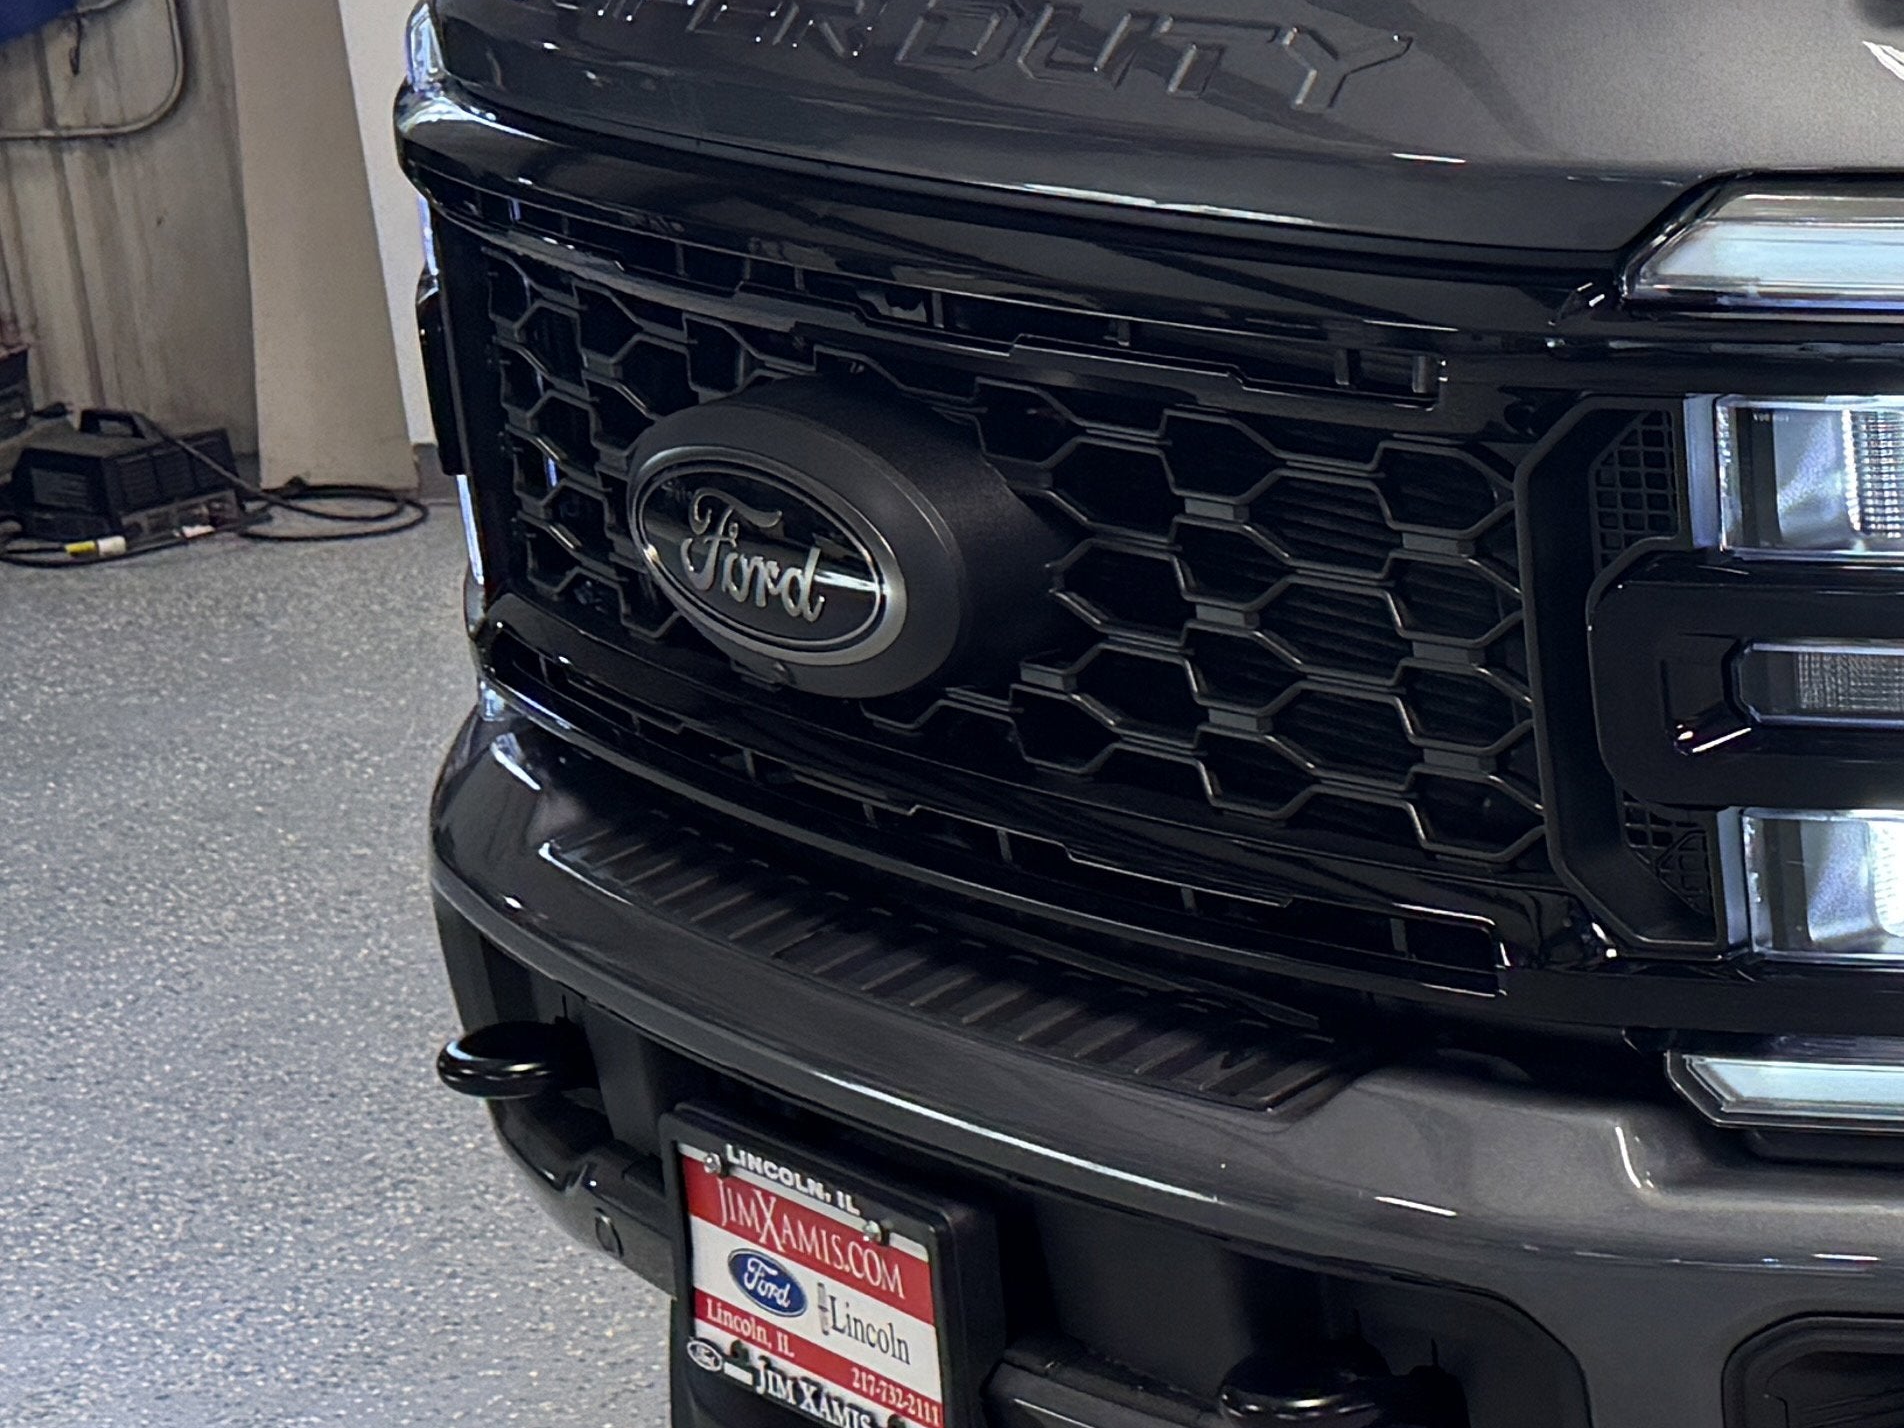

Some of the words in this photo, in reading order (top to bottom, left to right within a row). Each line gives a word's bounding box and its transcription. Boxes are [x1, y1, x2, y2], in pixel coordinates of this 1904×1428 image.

[679, 487, 826, 623] Ford
[724, 1143, 832, 1204] LINCOLN,
[836, 1189, 861, 1217] IL
[716, 1176, 906, 1300] JIMXAMIS.COM
[743, 1256, 791, 1309] Ford
[705, 1298, 772, 1349] Lincoln,
[775, 1334, 796, 1359] IL
[830, 1294, 911, 1366] Lincoln
[755, 1357, 796, 1402] JIM
[850, 1367, 941, 1427] 217-732-2111
